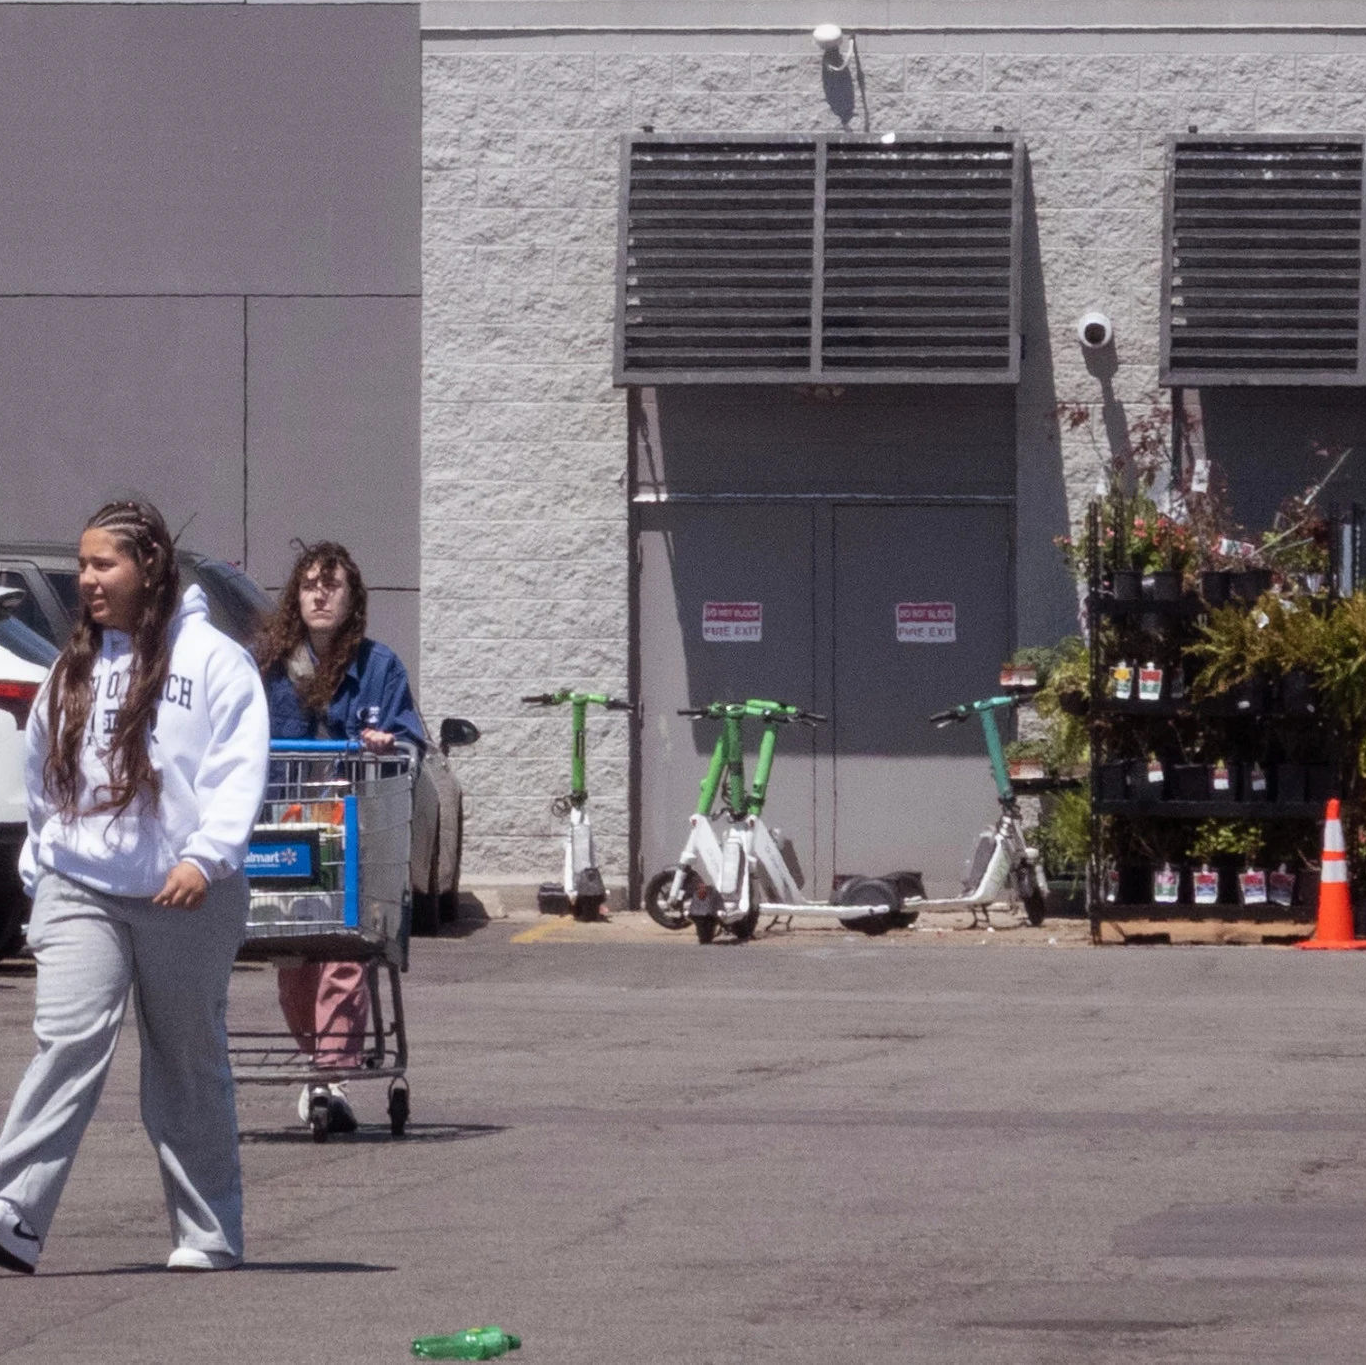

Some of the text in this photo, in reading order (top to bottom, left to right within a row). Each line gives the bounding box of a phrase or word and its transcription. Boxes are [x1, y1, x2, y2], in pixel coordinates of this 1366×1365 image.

[705, 626, 759, 636] FIRE EXIT
[899, 626, 953, 637] FIRE EXIT
[243, 851, 280, 863] almart
